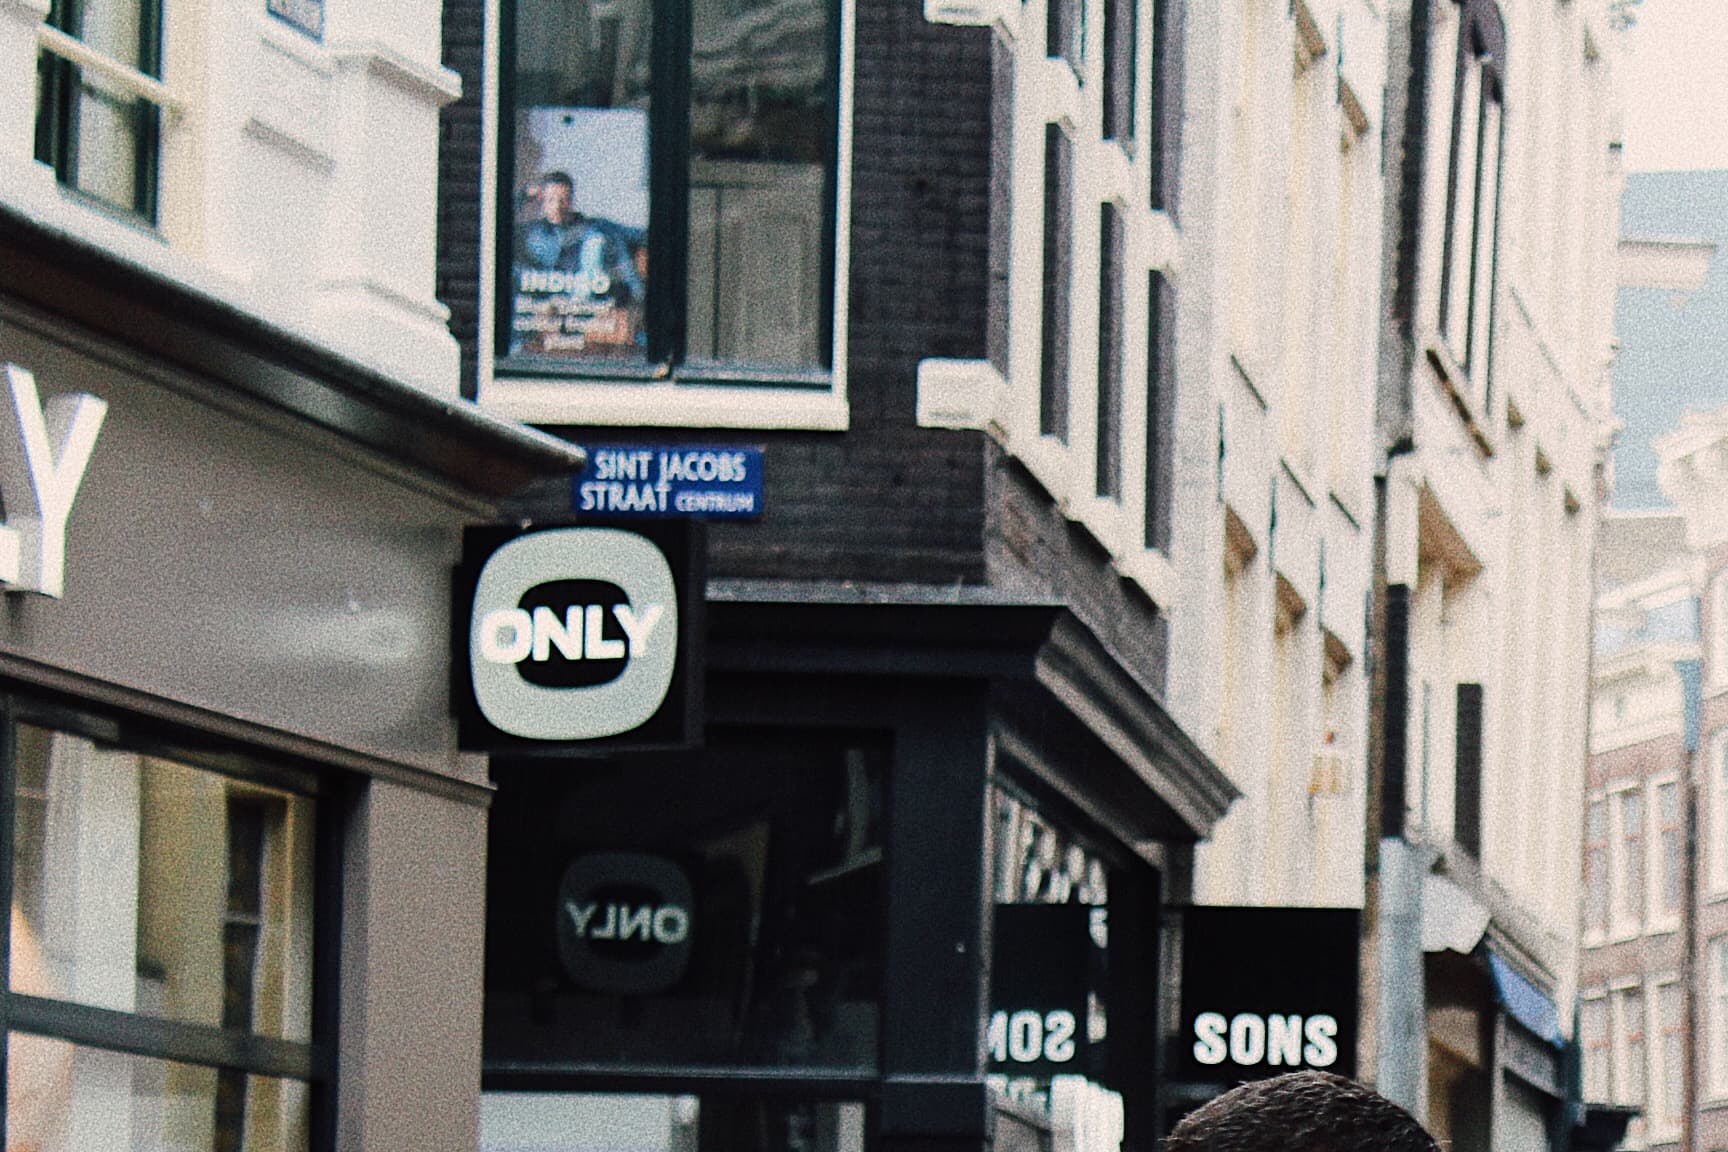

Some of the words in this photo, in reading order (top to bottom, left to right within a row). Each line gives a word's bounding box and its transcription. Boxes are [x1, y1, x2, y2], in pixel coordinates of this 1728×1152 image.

[594, 451, 653, 481] SINT
[657, 452, 747, 486] JACOBS
[580, 481, 671, 512] STRAAT
[674, 490, 755, 513] CENTRUM
[480, 604, 664, 664] ONLY
[1193, 1011, 1338, 1067] SONS
